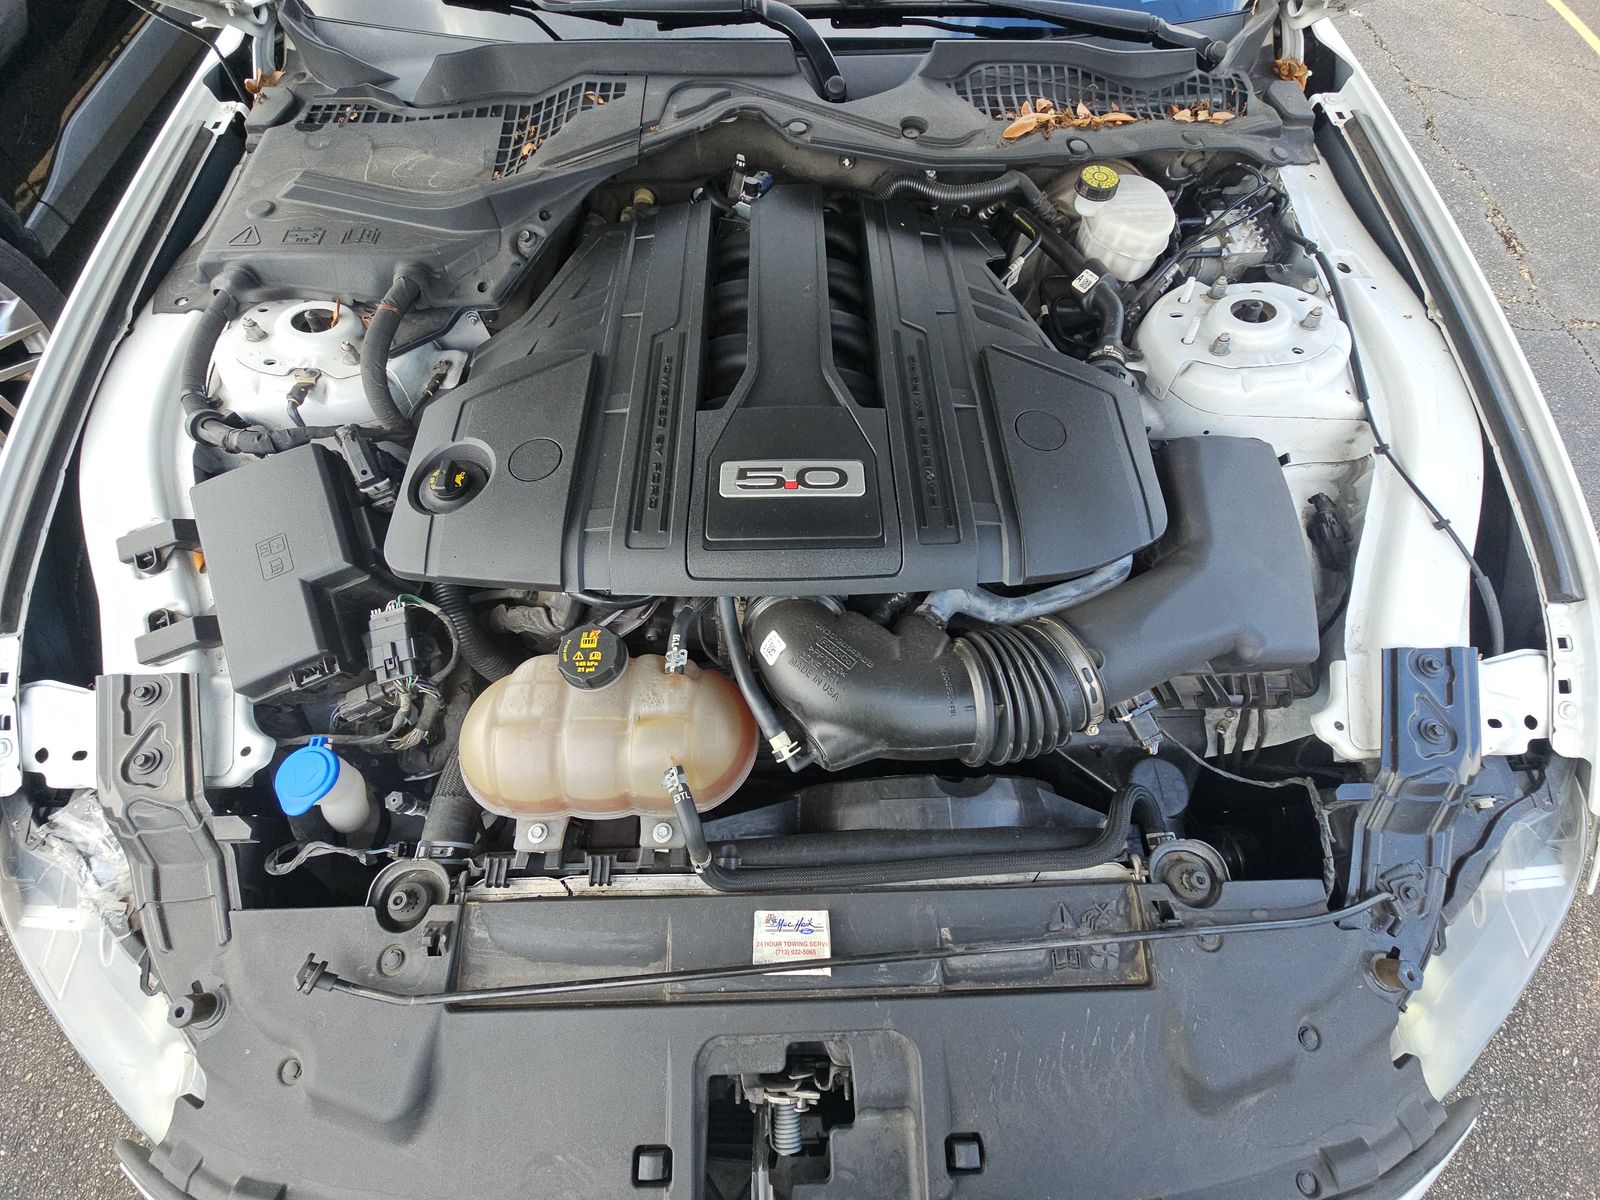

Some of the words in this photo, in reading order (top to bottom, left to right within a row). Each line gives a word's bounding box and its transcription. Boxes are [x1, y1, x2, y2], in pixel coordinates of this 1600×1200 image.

[658, 355, 672, 428] POWERED
[655, 434, 665, 456] BY
[648, 462, 662, 510] FORD
[735, 467, 848, 489] 5.0
[820, 639, 852, 665] FoMoCo
[789, 657, 811, 678] MADE
[812, 674, 822, 686] IN
[822, 683, 840, 701] USA
[673, 791, 691, 804] BTL
